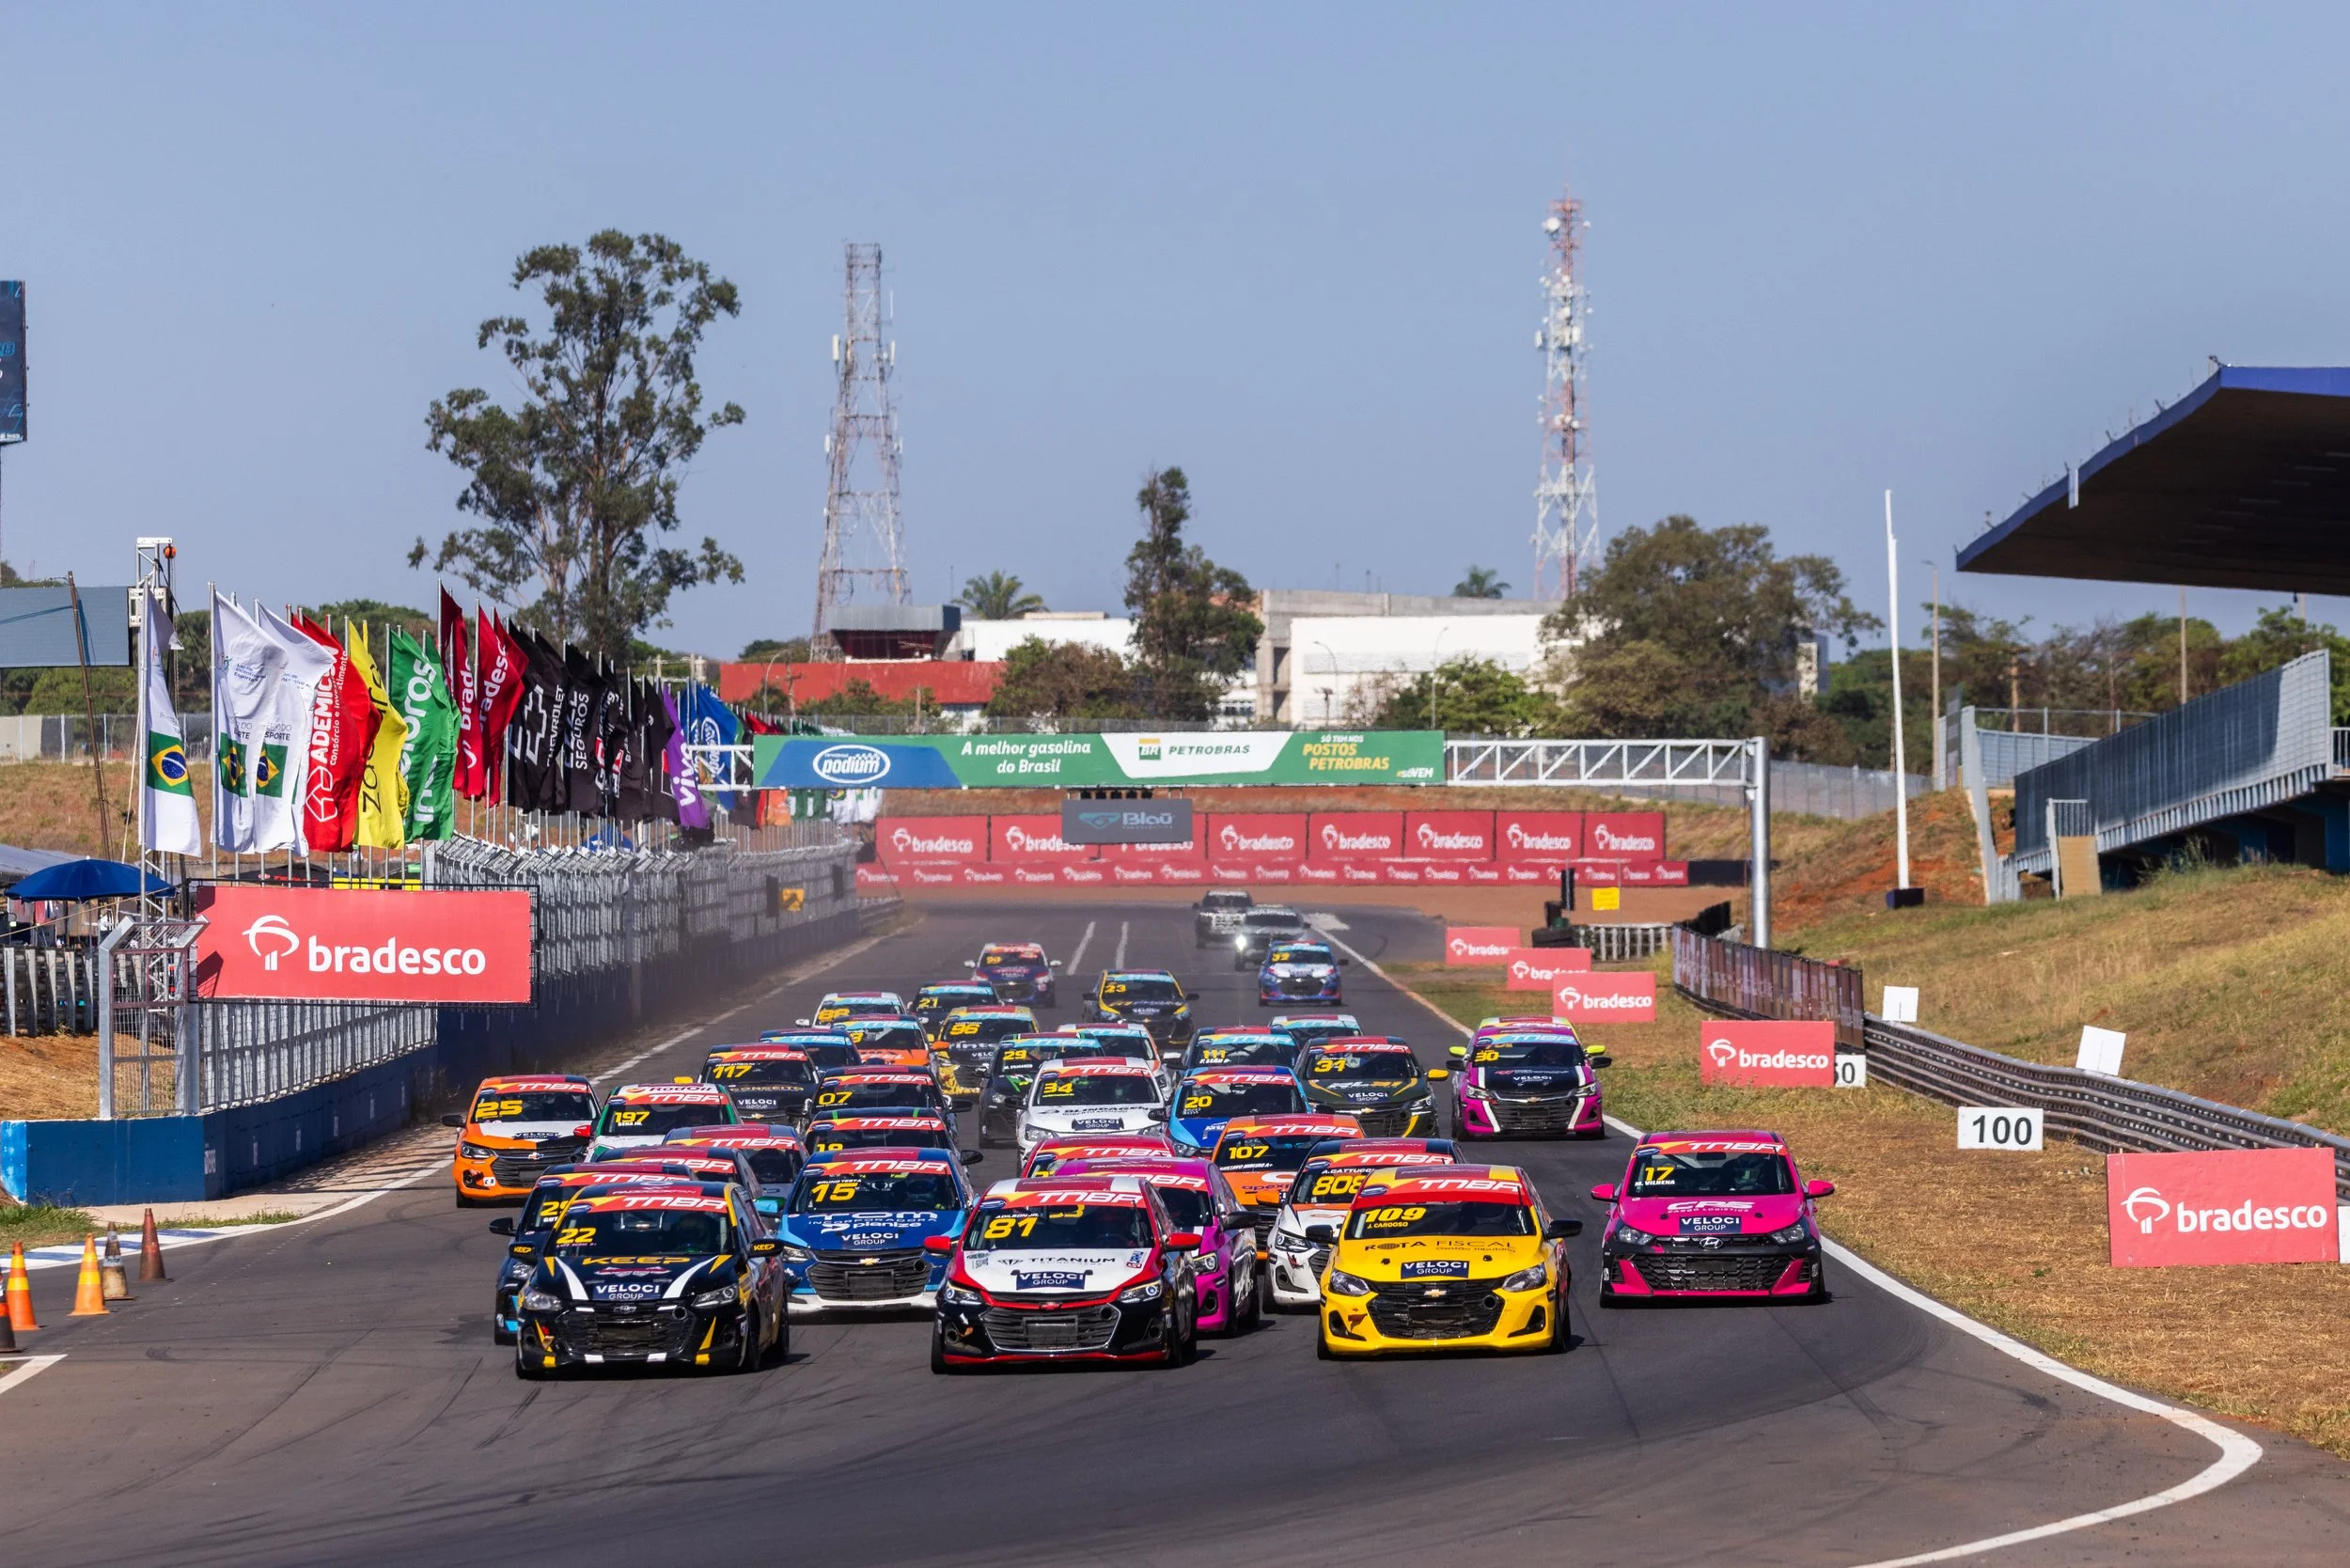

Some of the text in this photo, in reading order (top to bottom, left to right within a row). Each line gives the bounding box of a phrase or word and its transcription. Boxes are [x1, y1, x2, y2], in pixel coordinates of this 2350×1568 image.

[546, 683, 565, 767] EVROLET
[575, 693, 589, 770] SEGUROS
[265, 730, 290, 741] SPORTE
[962, 741, 1091, 758] A melhor gasolina
[1139, 744, 1250, 758] BR PETROBRAS
[1302, 743, 1357, 756] POSTOS
[822, 756, 881, 775] podium
[996, 759, 1061, 774] do Brasil
[1309, 757, 1389, 770] PETROBRAS
[673, 741, 697, 807] vivo
[912, 837, 974, 854] bradesco
[1238, 834, 1294, 851] bradesco
[1339, 833, 1391, 850] bradesco
[1434, 832, 1483, 850] bradesco
[1523, 833, 1571, 850] bradesco
[1610, 834, 1654, 851] bradesco
[308, 935, 486, 976] bradesco
[1104, 984, 1126, 993] 23
[918, 998, 938, 1008] 21
[1583, 993, 1653, 1009] bradesco
[949, 1024, 980, 1036] 96
[1002, 1050, 1027, 1060] 29
[1203, 1049, 1227, 1059] 111
[1474, 1050, 1499, 1062] 30
[1739, 1048, 1829, 1070] bradesco
[713, 1065, 752, 1079] 117
[1043, 1082, 1073, 1094] 34
[818, 1091, 853, 1105] 07
[1185, 1095, 1213, 1108] 20
[476, 1100, 523, 1119] 25
[615, 1110, 650, 1123] 197
[1972, 1115, 2032, 1145] 100
[1229, 1145, 1269, 1160] 107
[1645, 1167, 1674, 1182] 17
[811, 1183, 859, 1203] 15
[1311, 1175, 1367, 1196] 808
[1364, 1207, 1427, 1223] 109
[2177, 1200, 2327, 1232] bradesco
[984, 1216, 1039, 1239] 81
[556, 1227, 596, 1244] 22
[841, 1232, 899, 1241] VELOCI
[1436, 1240, 1516, 1248] FISCAL
[582, 1257, 691, 1265] KEEP
[596, 1284, 660, 1294] VELOCI
